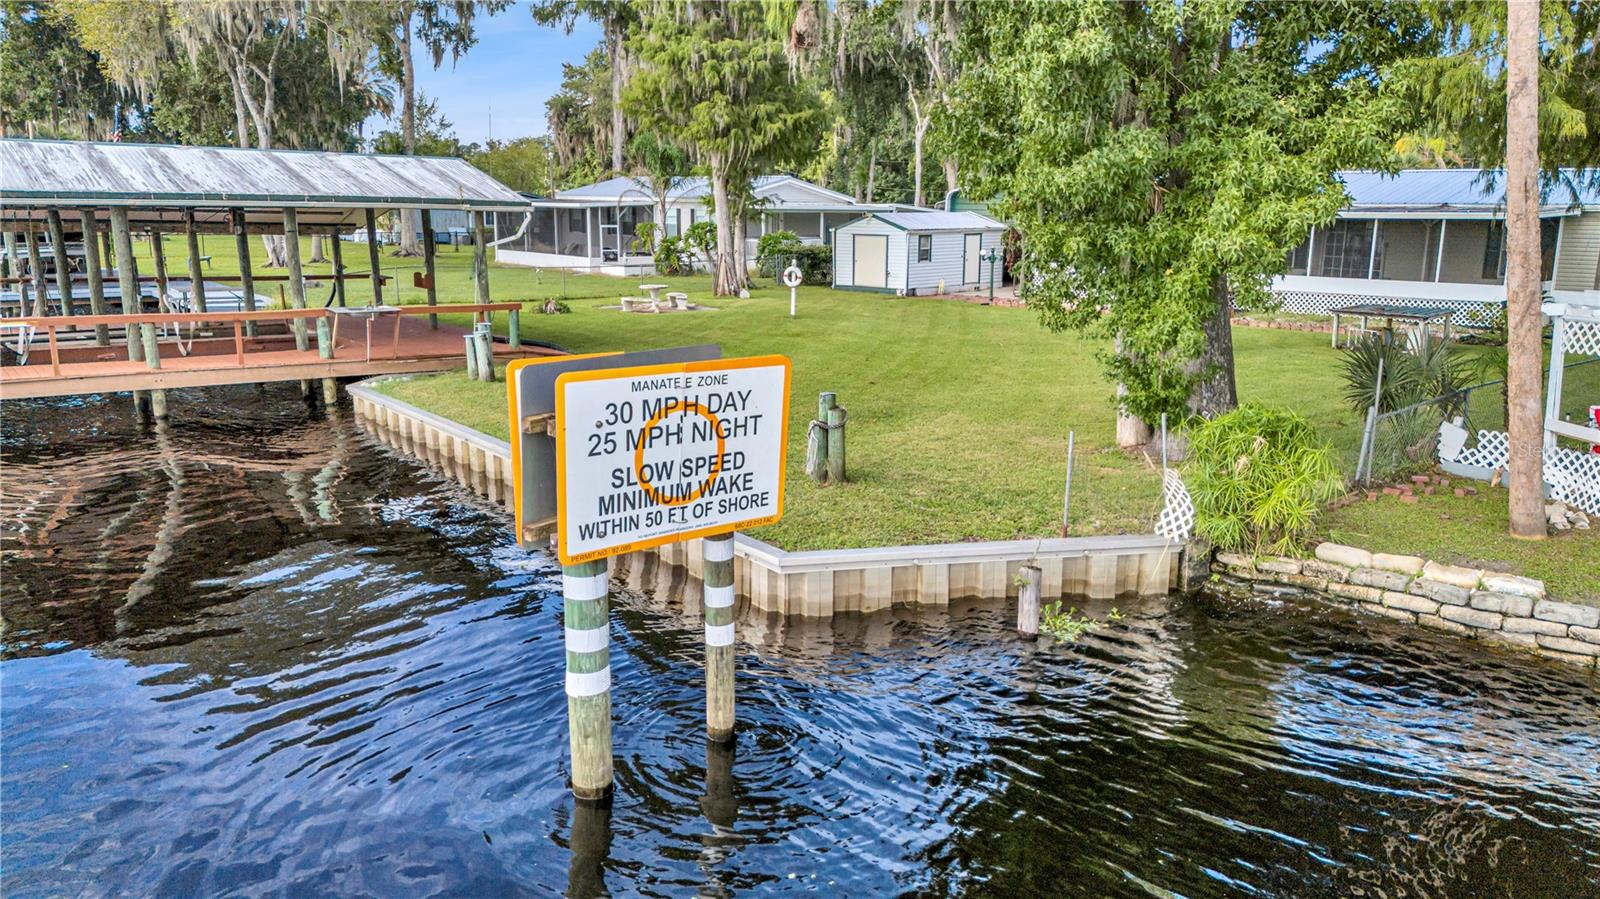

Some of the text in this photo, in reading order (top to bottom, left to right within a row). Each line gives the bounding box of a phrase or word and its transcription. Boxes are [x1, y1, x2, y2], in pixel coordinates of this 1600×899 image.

[631, 374, 729, 392] MANATEE ZONE
[605, 389, 752, 426] 30 MPH DAY
[588, 414, 763, 457] 25 MPH NIGHT
[611, 451, 745, 489] SLOW SPEED
[598, 472, 754, 516] MINIMUM WAKE
[578, 514, 640, 541] WITHIN
[645, 510, 663, 528] 50
[668, 506, 688, 524] FT
[692, 501, 713, 519] OF
[718, 491, 769, 514] SHORE
[571, 551, 596, 562] PERMIT
